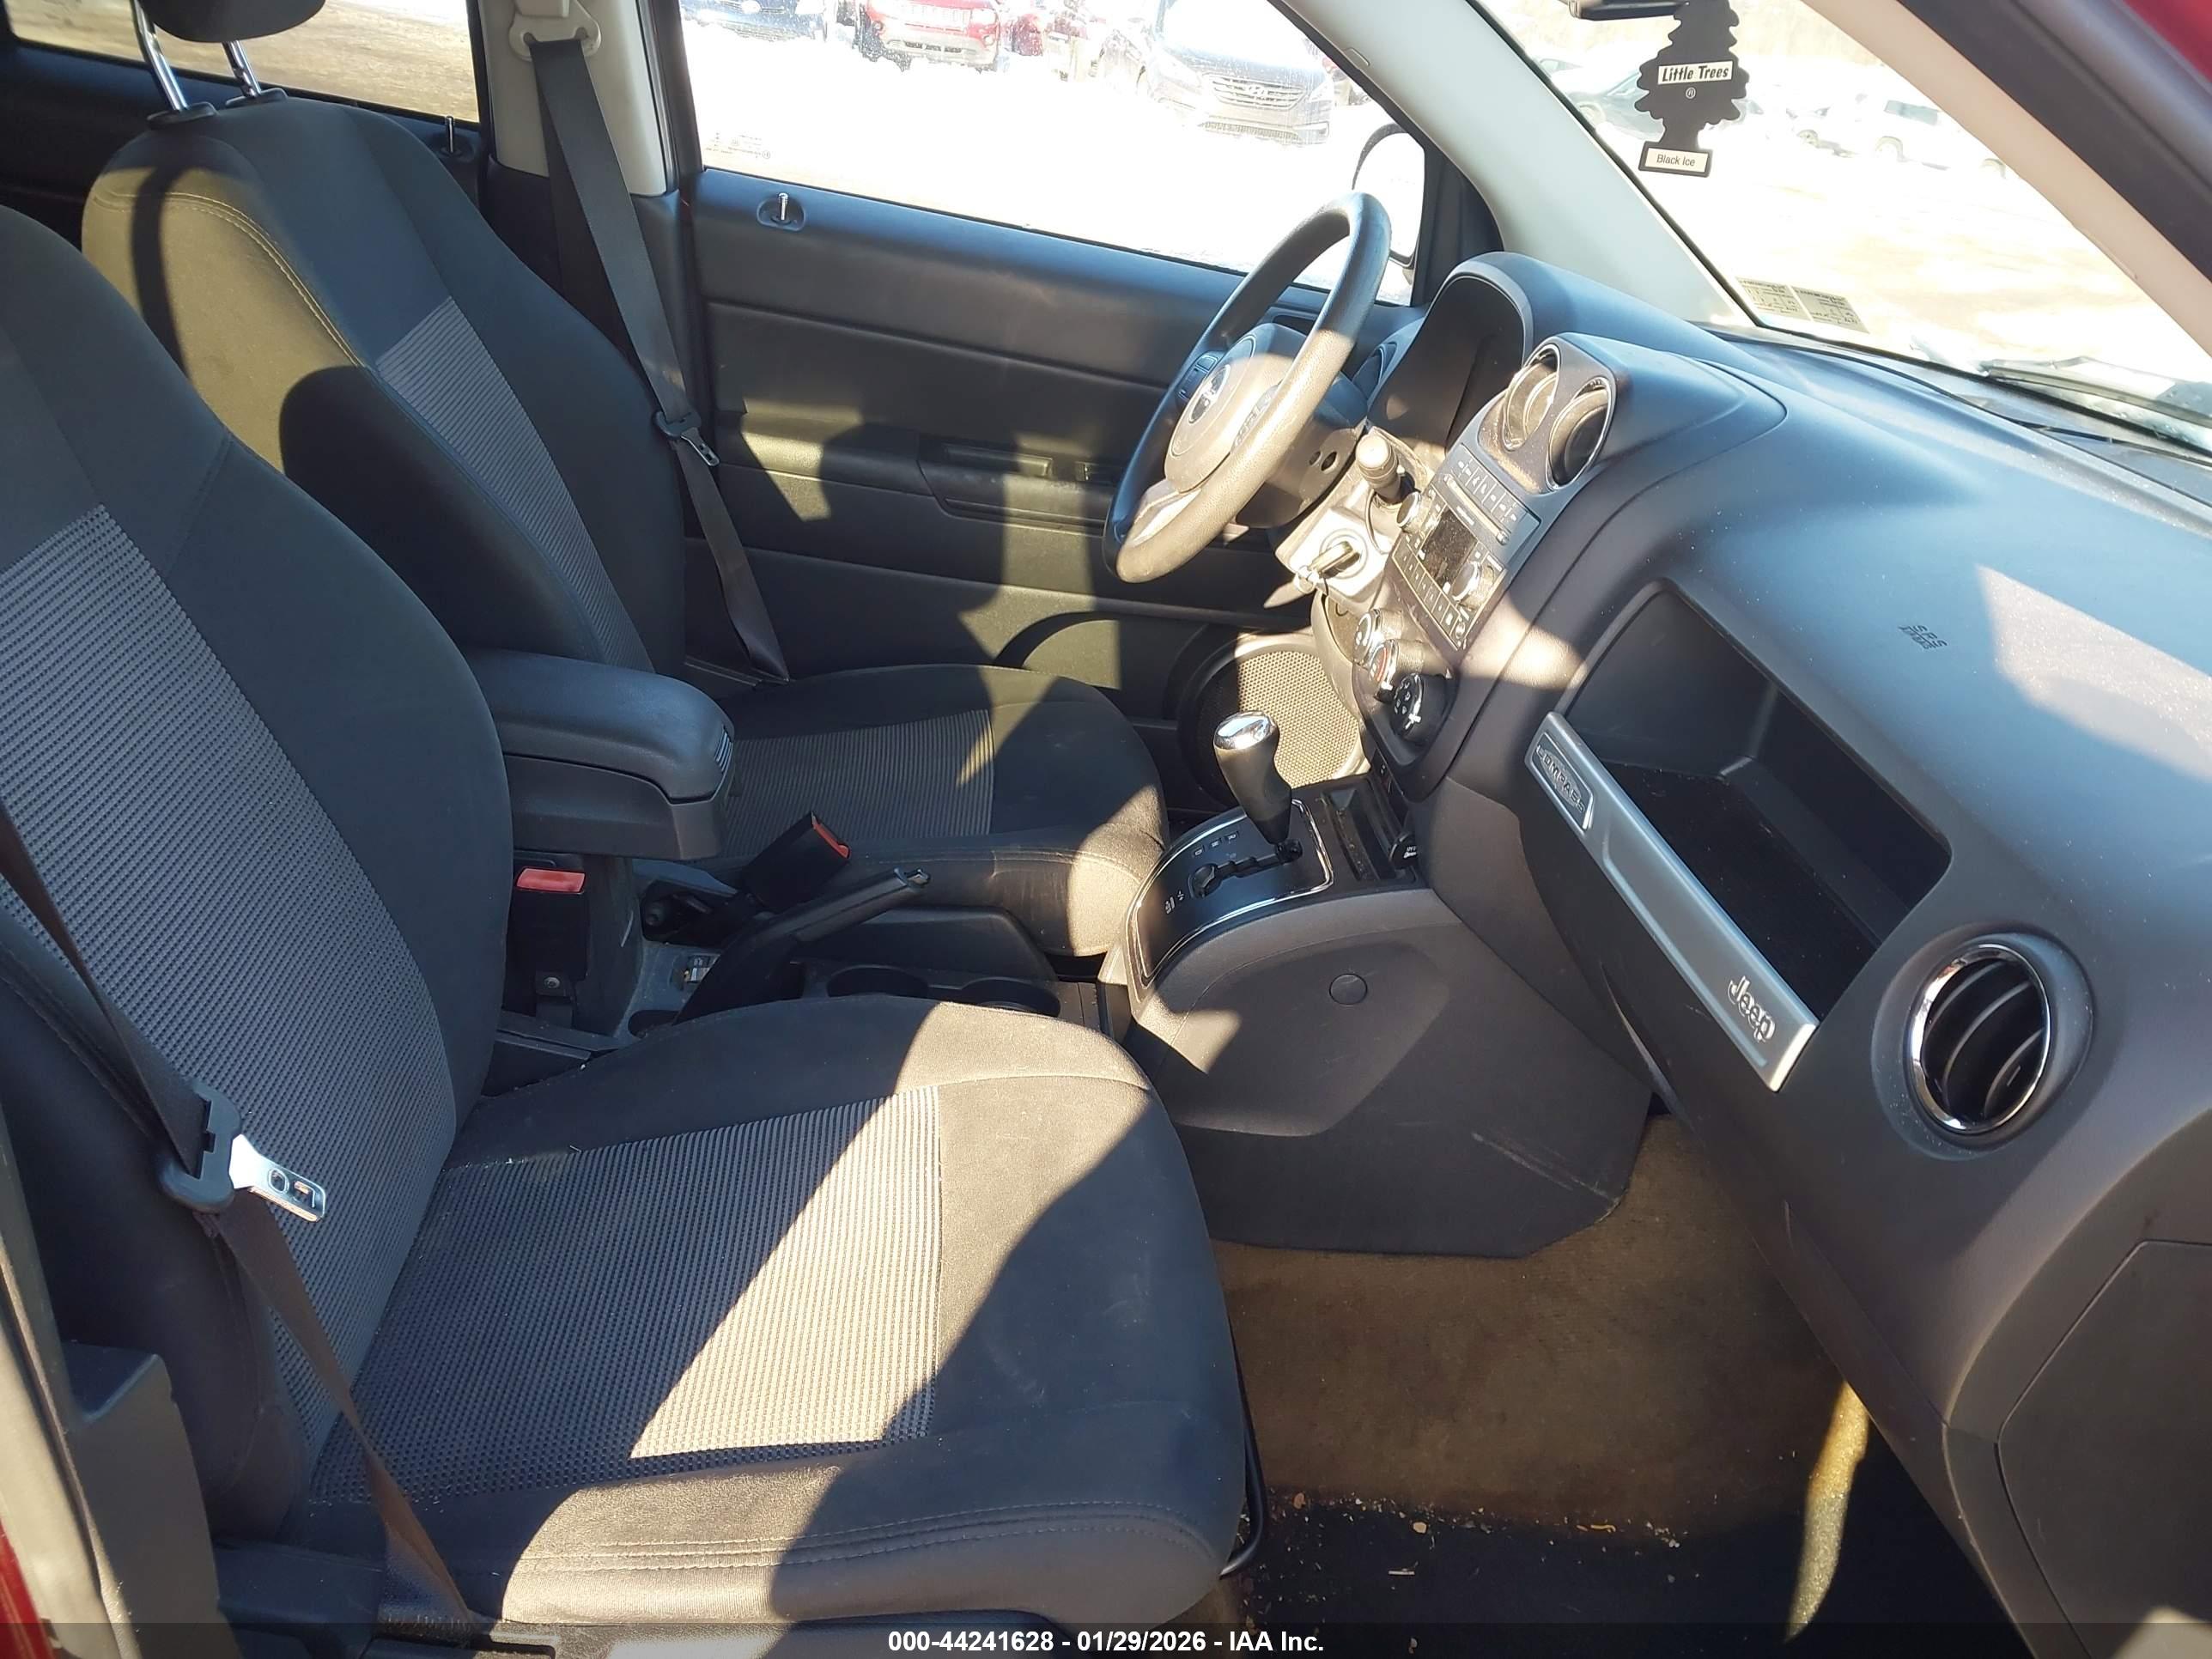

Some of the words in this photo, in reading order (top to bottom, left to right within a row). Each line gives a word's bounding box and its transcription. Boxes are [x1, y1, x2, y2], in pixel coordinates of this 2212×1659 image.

[1662, 66, 1693, 82] Little
[1698, 64, 1729, 80] Trees
[1656, 154, 1680, 166] Black
[1681, 155, 1696, 167] Ice
[1535, 744, 1586, 814] COMPASS
[1727, 975, 1776, 1042] Jeep
